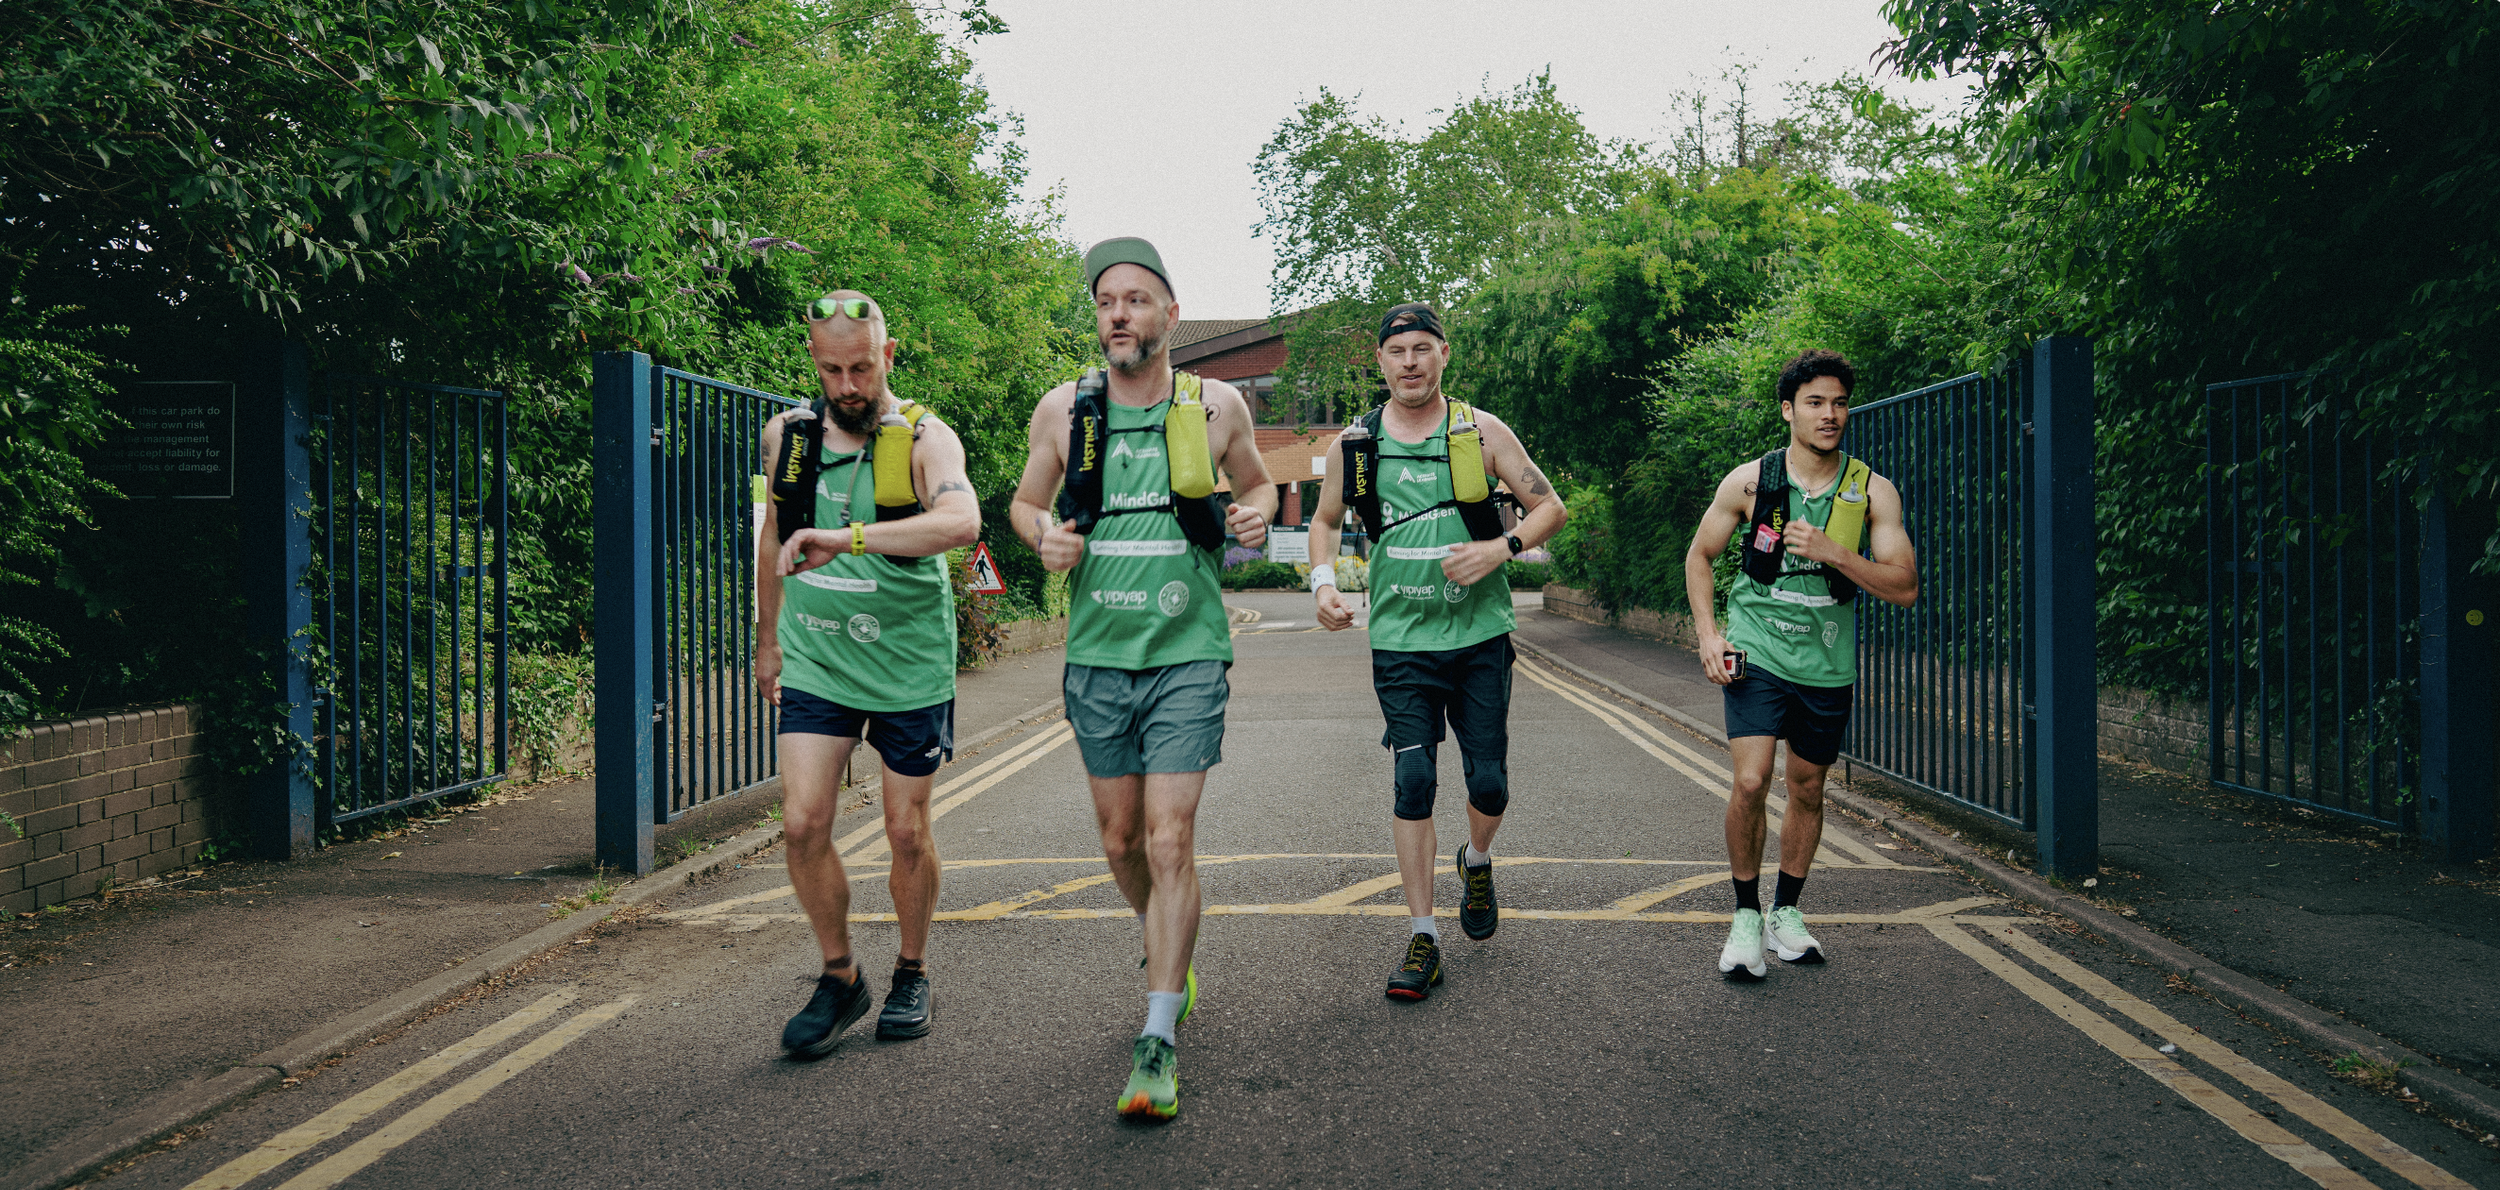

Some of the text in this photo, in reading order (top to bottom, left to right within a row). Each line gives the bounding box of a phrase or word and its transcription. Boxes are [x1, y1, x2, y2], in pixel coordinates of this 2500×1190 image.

[139, 406, 157, 415] this
[181, 406, 203, 417] park
[207, 406, 220, 415] do
[186, 420, 205, 429] risk
[144, 435, 209, 445] management
[165, 449, 202, 459] liability
[206, 449, 220, 457] for
[178, 463, 221, 473] damage.
